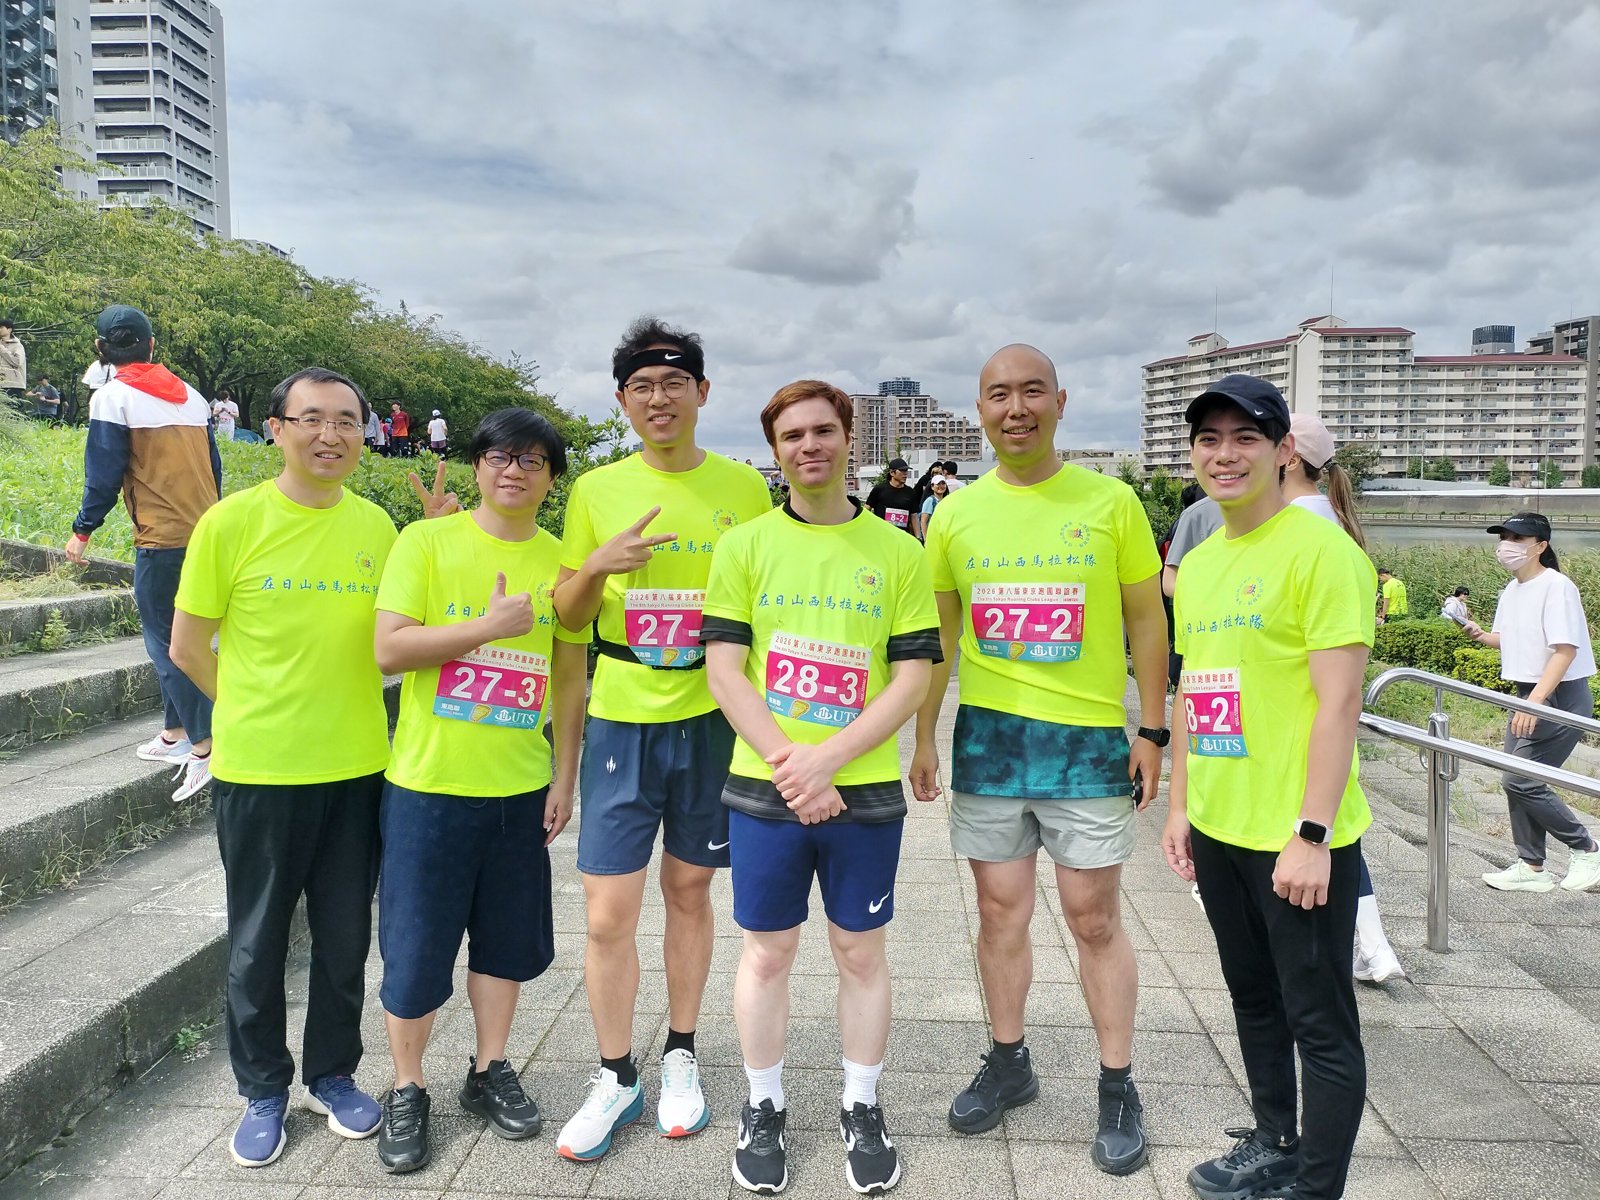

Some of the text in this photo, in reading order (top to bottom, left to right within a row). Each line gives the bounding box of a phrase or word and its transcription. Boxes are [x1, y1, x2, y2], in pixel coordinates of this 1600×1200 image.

[965, 553, 1096, 571] 在日山西馬拉松隊
[758, 592, 882, 619] 在日山西馬拉松隊
[985, 607, 1072, 640] 27-2
[1048, 645, 1077, 657] UTS
[450, 666, 537, 708] 27-3
[773, 659, 859, 705] 28-3
[511, 713, 536, 724] UTS
[1212, 738, 1242, 751] UTS
